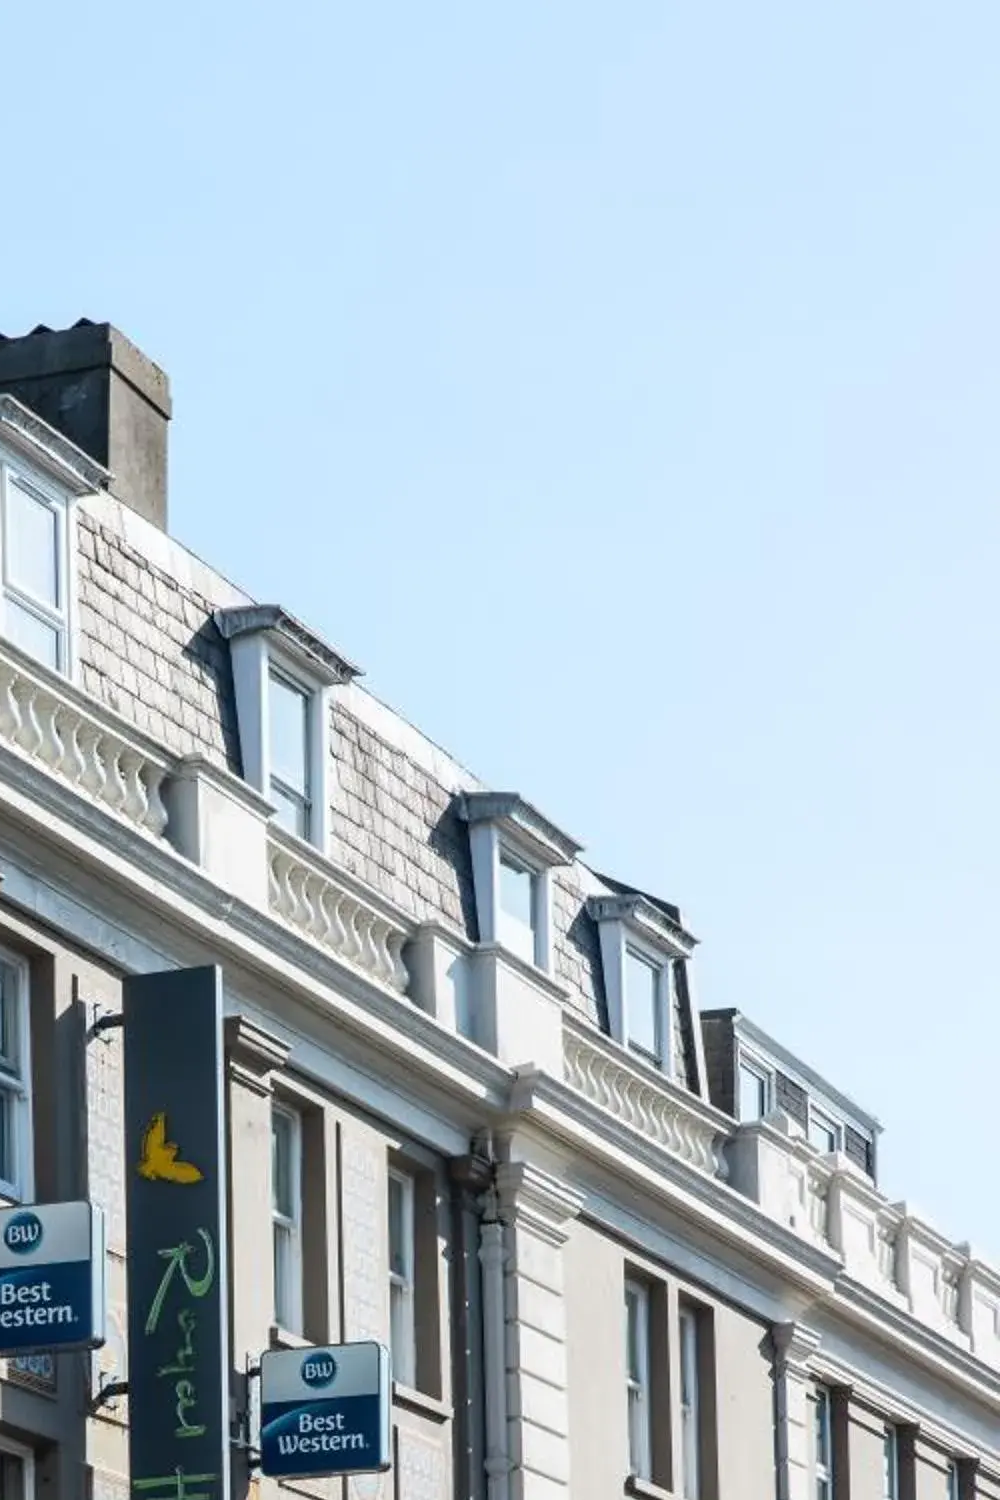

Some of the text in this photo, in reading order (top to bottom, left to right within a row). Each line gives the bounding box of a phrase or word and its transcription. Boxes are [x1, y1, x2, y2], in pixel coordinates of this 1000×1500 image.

[8, 1224, 39, 1244] BW
[0, 1281, 51, 1305] Best
[145, 1228, 216, 1438] Royal
[305, 1362, 333, 1379] BW
[299, 1413, 345, 1433] Best
[277, 1433, 364, 1455] Western
